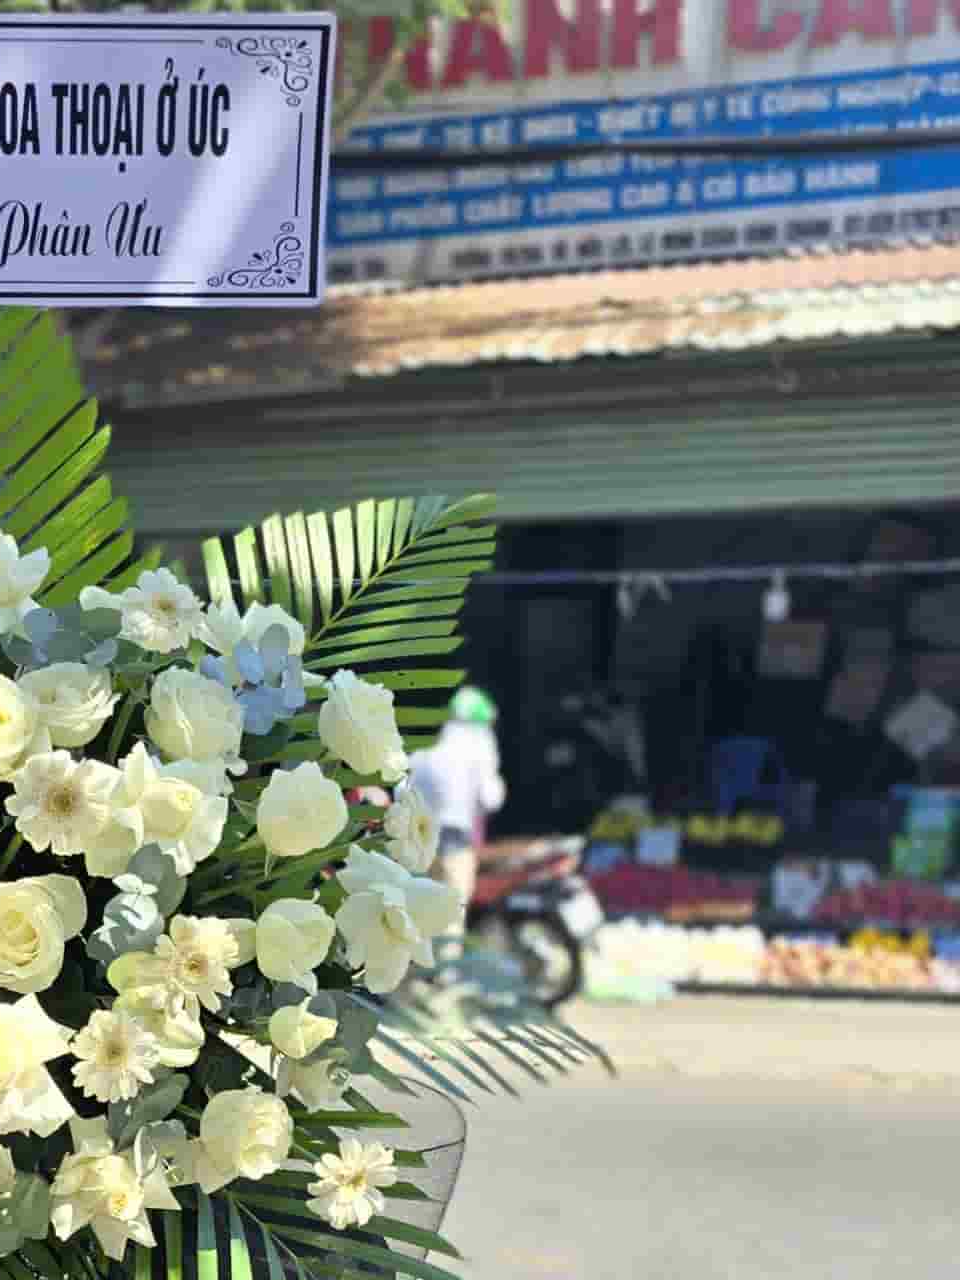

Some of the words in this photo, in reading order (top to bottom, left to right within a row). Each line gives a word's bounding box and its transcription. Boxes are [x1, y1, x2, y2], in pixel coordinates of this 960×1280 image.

[51, 82, 145, 173] THOẠI
[156, 57, 179, 157] Ở
[188, 67, 231, 157] ÚC
[105, 197, 163, 257] Ưu
